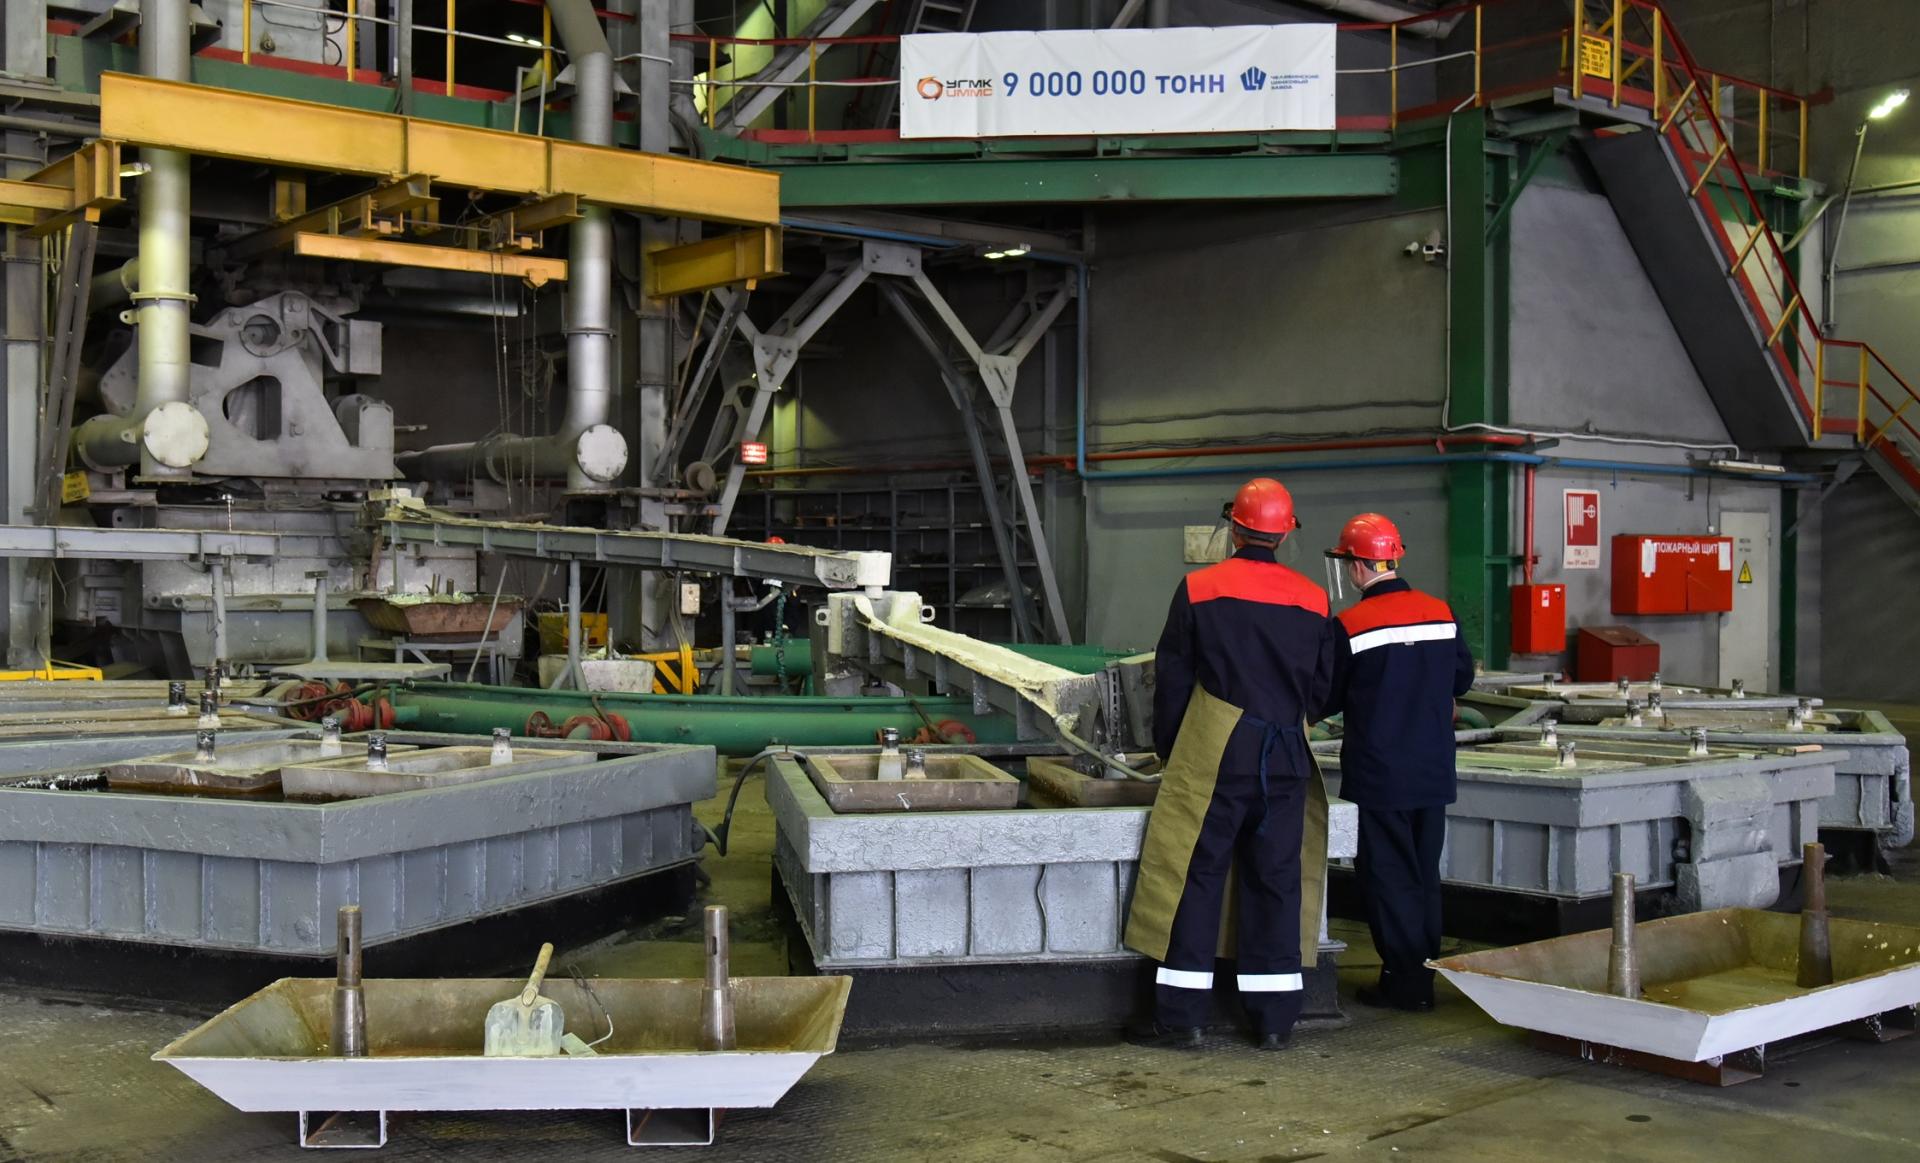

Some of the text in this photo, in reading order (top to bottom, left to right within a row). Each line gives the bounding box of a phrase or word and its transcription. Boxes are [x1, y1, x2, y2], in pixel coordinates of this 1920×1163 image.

[946, 79, 992, 89] УГМК
[1002, 69, 1225, 97] 9 000 000 тонн
[946, 88, 993, 97] UMMC
[1656, 542, 1718, 556] ПОЖАРНЫЙ ЩИТ
